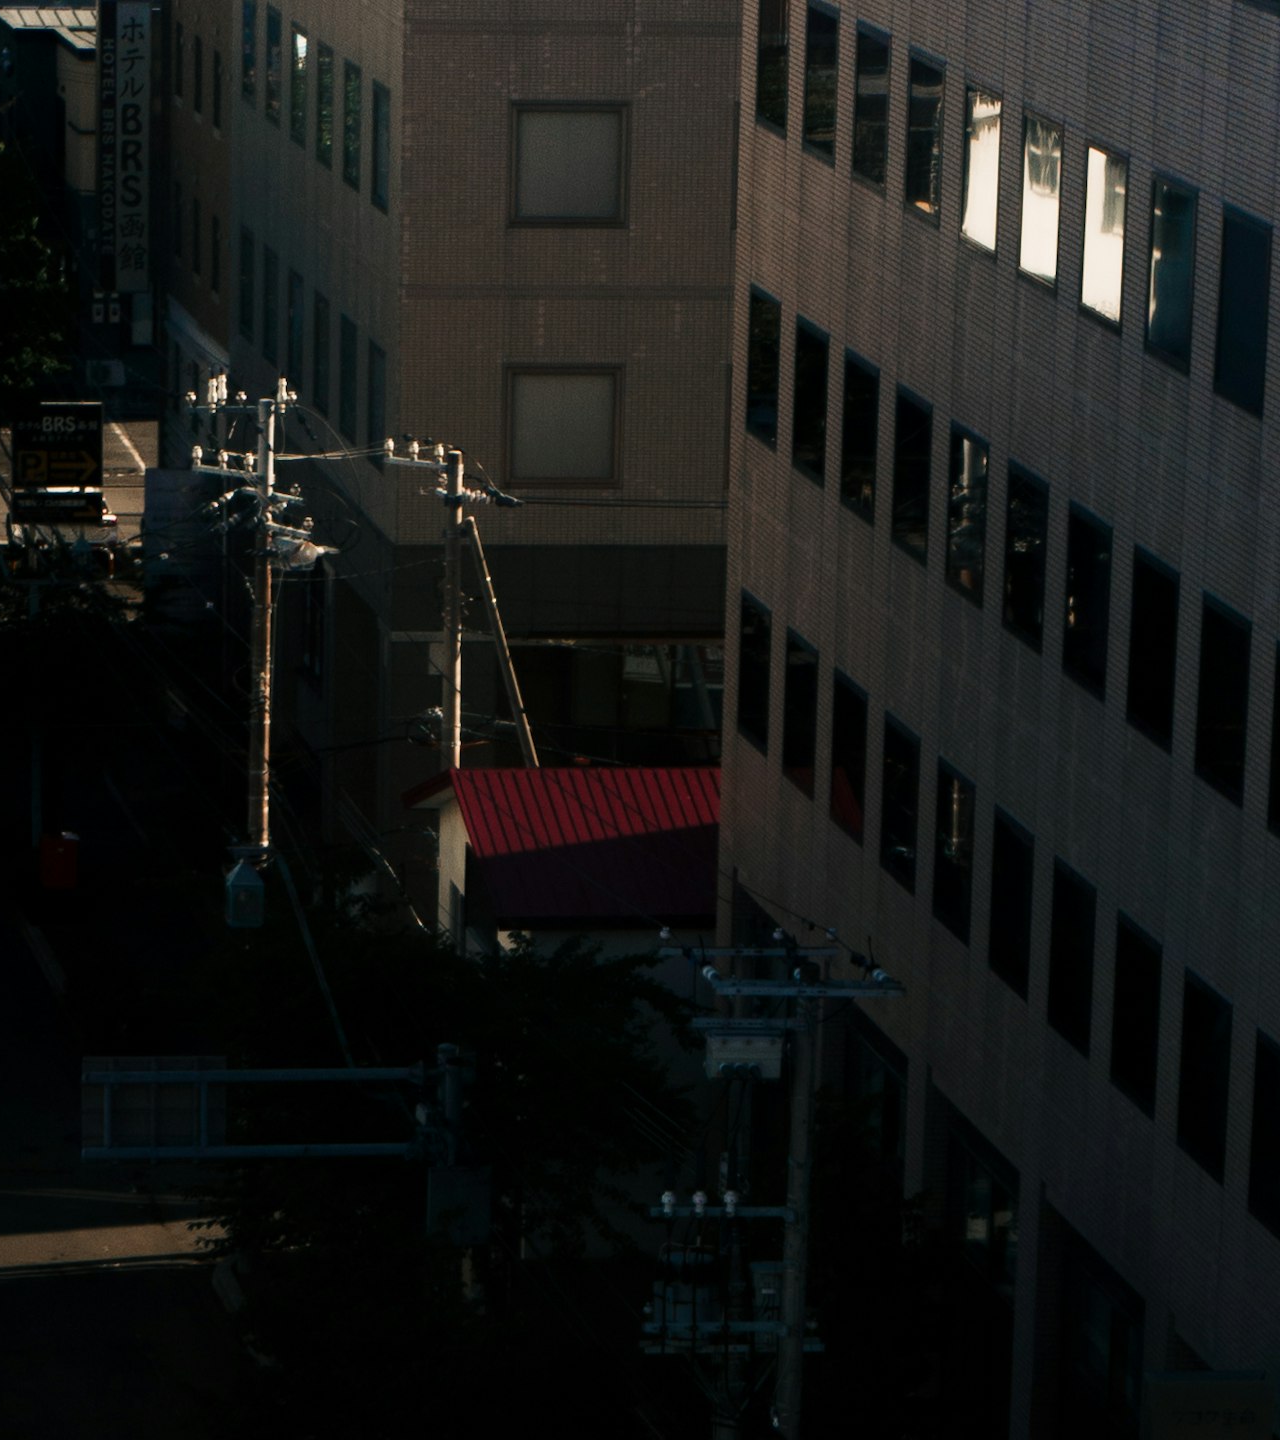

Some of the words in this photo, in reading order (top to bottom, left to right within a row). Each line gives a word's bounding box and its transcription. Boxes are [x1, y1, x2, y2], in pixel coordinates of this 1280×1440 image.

[102, 38, 115, 100] HOTEL
[102, 109, 115, 146] BRS
[118, 17, 147, 272] ホテルBRS函館
[102, 155, 115, 256] HAKODATE
[1171, 1408, 1256, 1425] フコク生命
